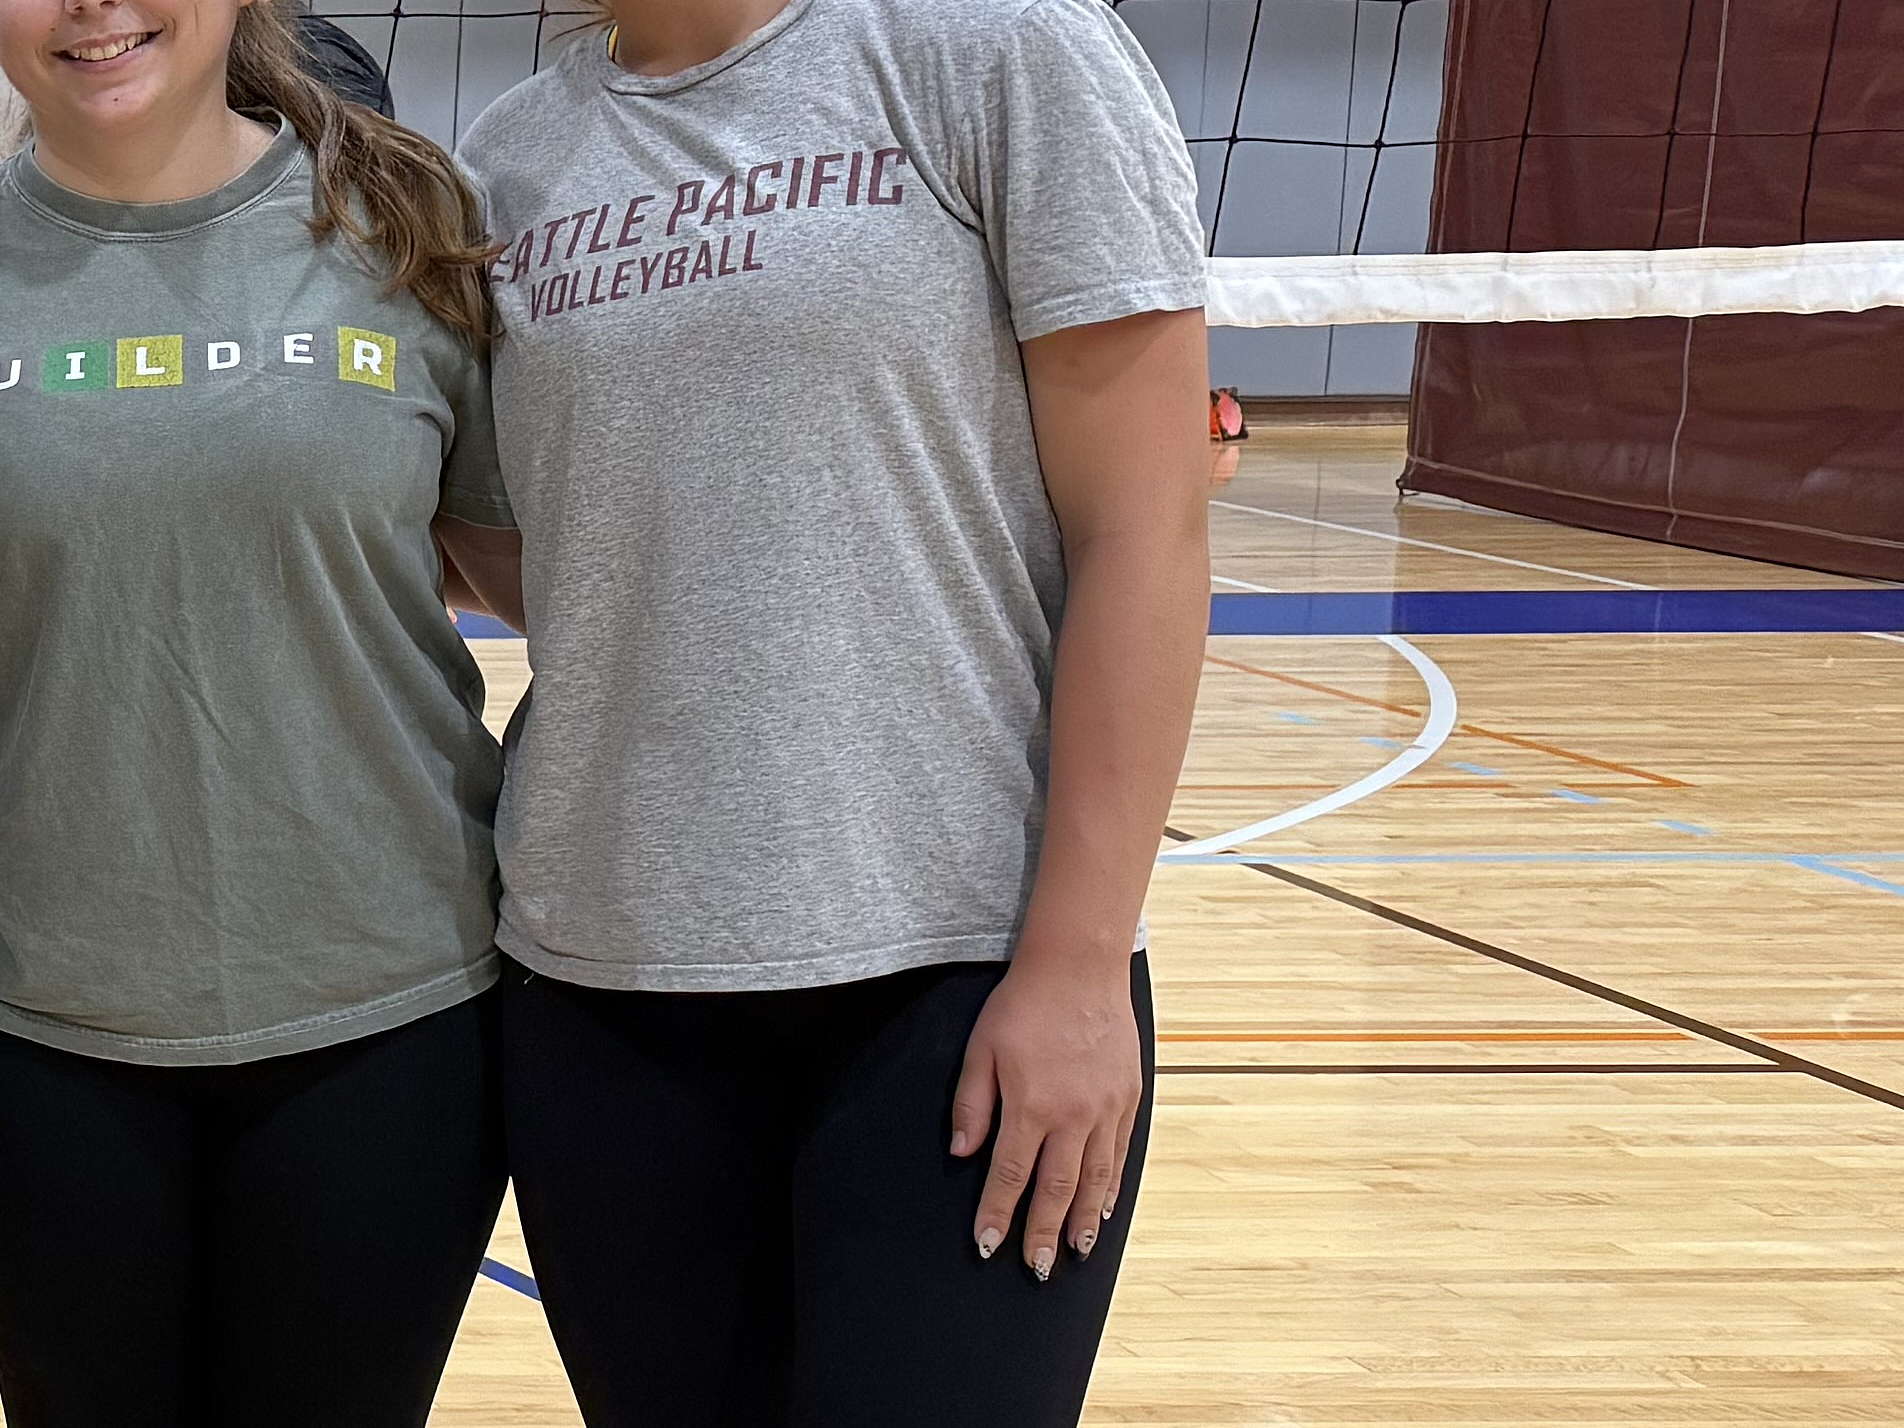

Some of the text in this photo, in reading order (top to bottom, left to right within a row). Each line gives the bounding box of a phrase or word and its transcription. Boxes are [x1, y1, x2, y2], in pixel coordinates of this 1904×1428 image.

[487, 147, 908, 283] EATTLE PACIFIC
[529, 229, 763, 322] VOLLEYBALL
